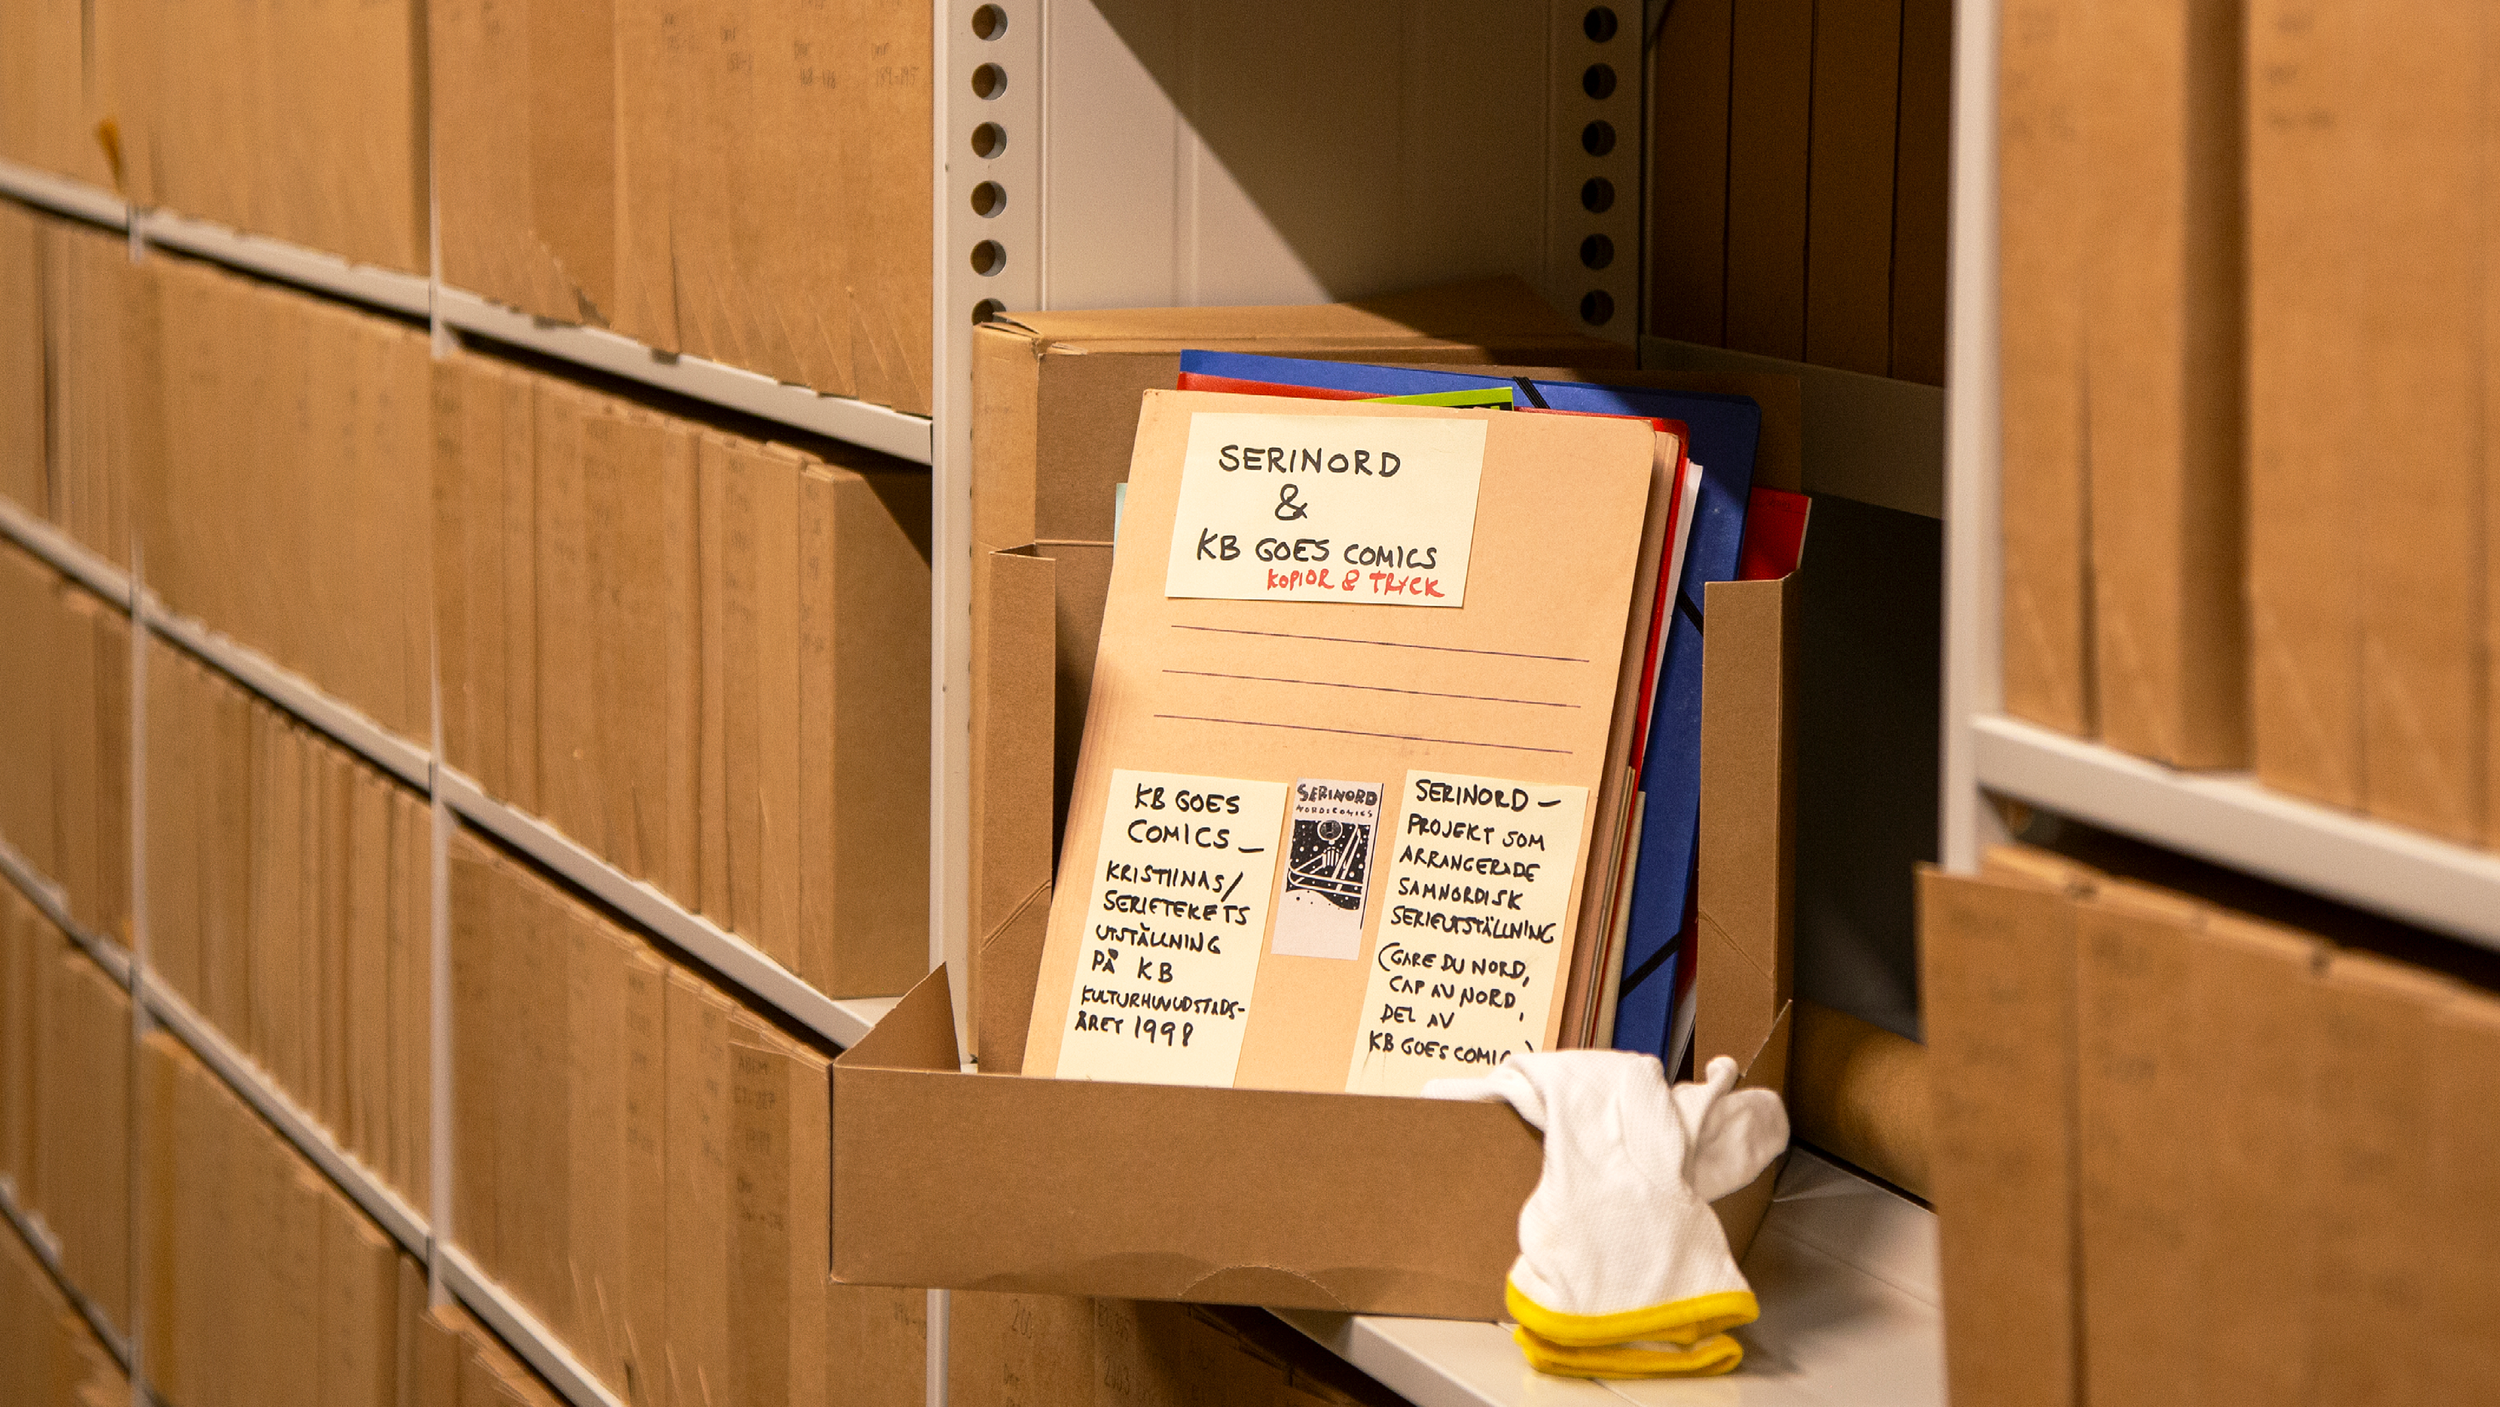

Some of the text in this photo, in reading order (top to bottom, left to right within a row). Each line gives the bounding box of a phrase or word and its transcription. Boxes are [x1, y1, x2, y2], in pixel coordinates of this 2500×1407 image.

[1219, 444, 1401, 477] SERINORD
[1275, 483, 1308, 521] &
[1197, 527, 1437, 569] KB GOES COMICS
[1267, 568, 1446, 598] KOPIOR & TRYCK
[1135, 783, 1241, 814] KB GOES
[1297, 783, 1378, 806] SERINORD
[1415, 779, 1529, 812] SERINORD
[1128, 819, 1230, 849] COMICS
[1407, 813, 1545, 851] PROJEKT SOM
[1399, 845, 1541, 882] ARRANGERADE
[1103, 890, 1251, 925] SERIETEKETS
[1398, 877, 1524, 910] SAMNORDISK
[1095, 922, 1221, 955] UTSTÄLLNING
[1390, 905, 1557, 944] SERIEUTSTÄLLNING
[1092, 948, 1174, 983] PÅ KB
[1378, 942, 1530, 987] (GARE DU NORD,
[1389, 975, 1425, 995] CAP
[1431, 983, 1455, 999] AV
[1074, 1010, 1194, 1047] ÅRET 1998
[1380, 1004, 1455, 1029] DEL AV
[1369, 1030, 1535, 1066] KB GOES COMIC
